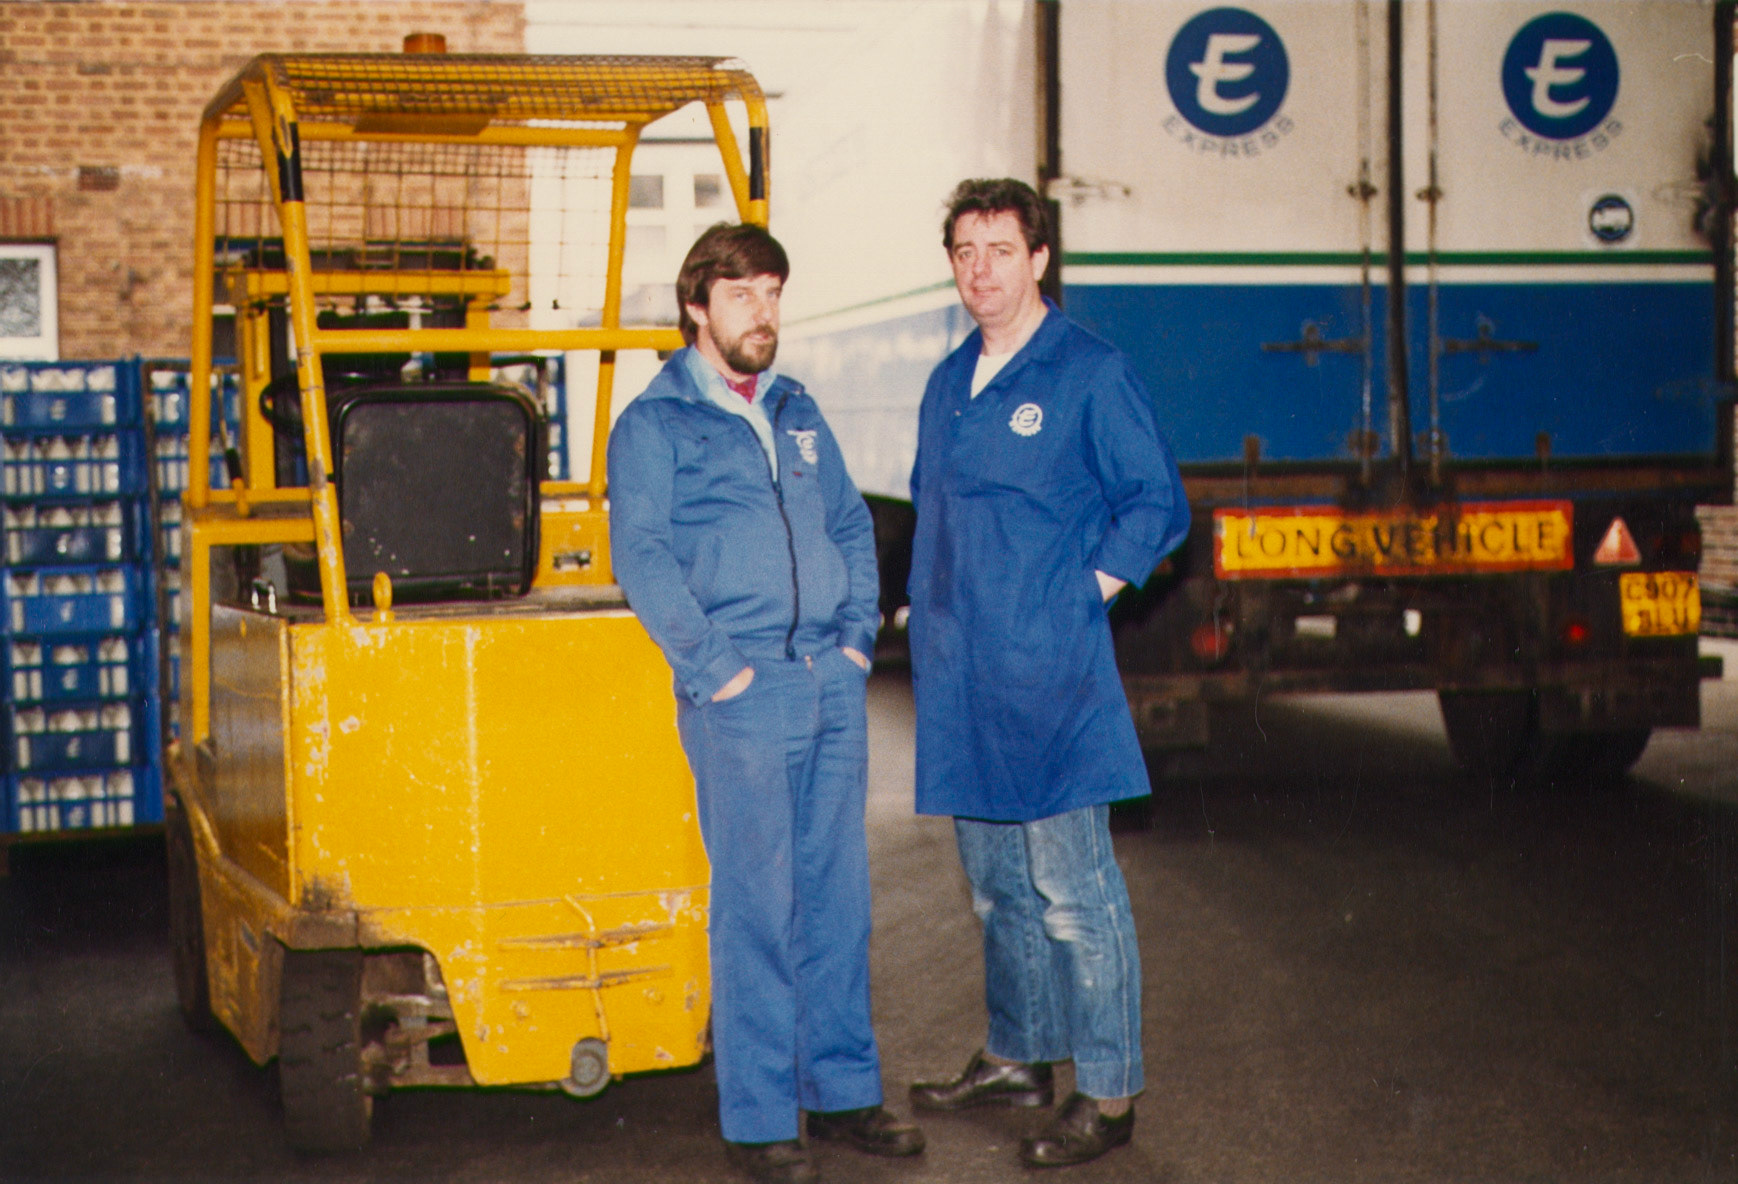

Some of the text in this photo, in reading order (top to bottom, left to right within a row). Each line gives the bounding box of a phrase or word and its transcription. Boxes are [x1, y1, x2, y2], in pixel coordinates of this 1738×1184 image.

[1188, 33, 1262, 117] E
[1523, 38, 1593, 118] E
[1162, 115, 1296, 158] EXPRESS
[1499, 117, 1624, 161] EXPRESS
[1237, 519, 1557, 561] LONG VEHICLE
